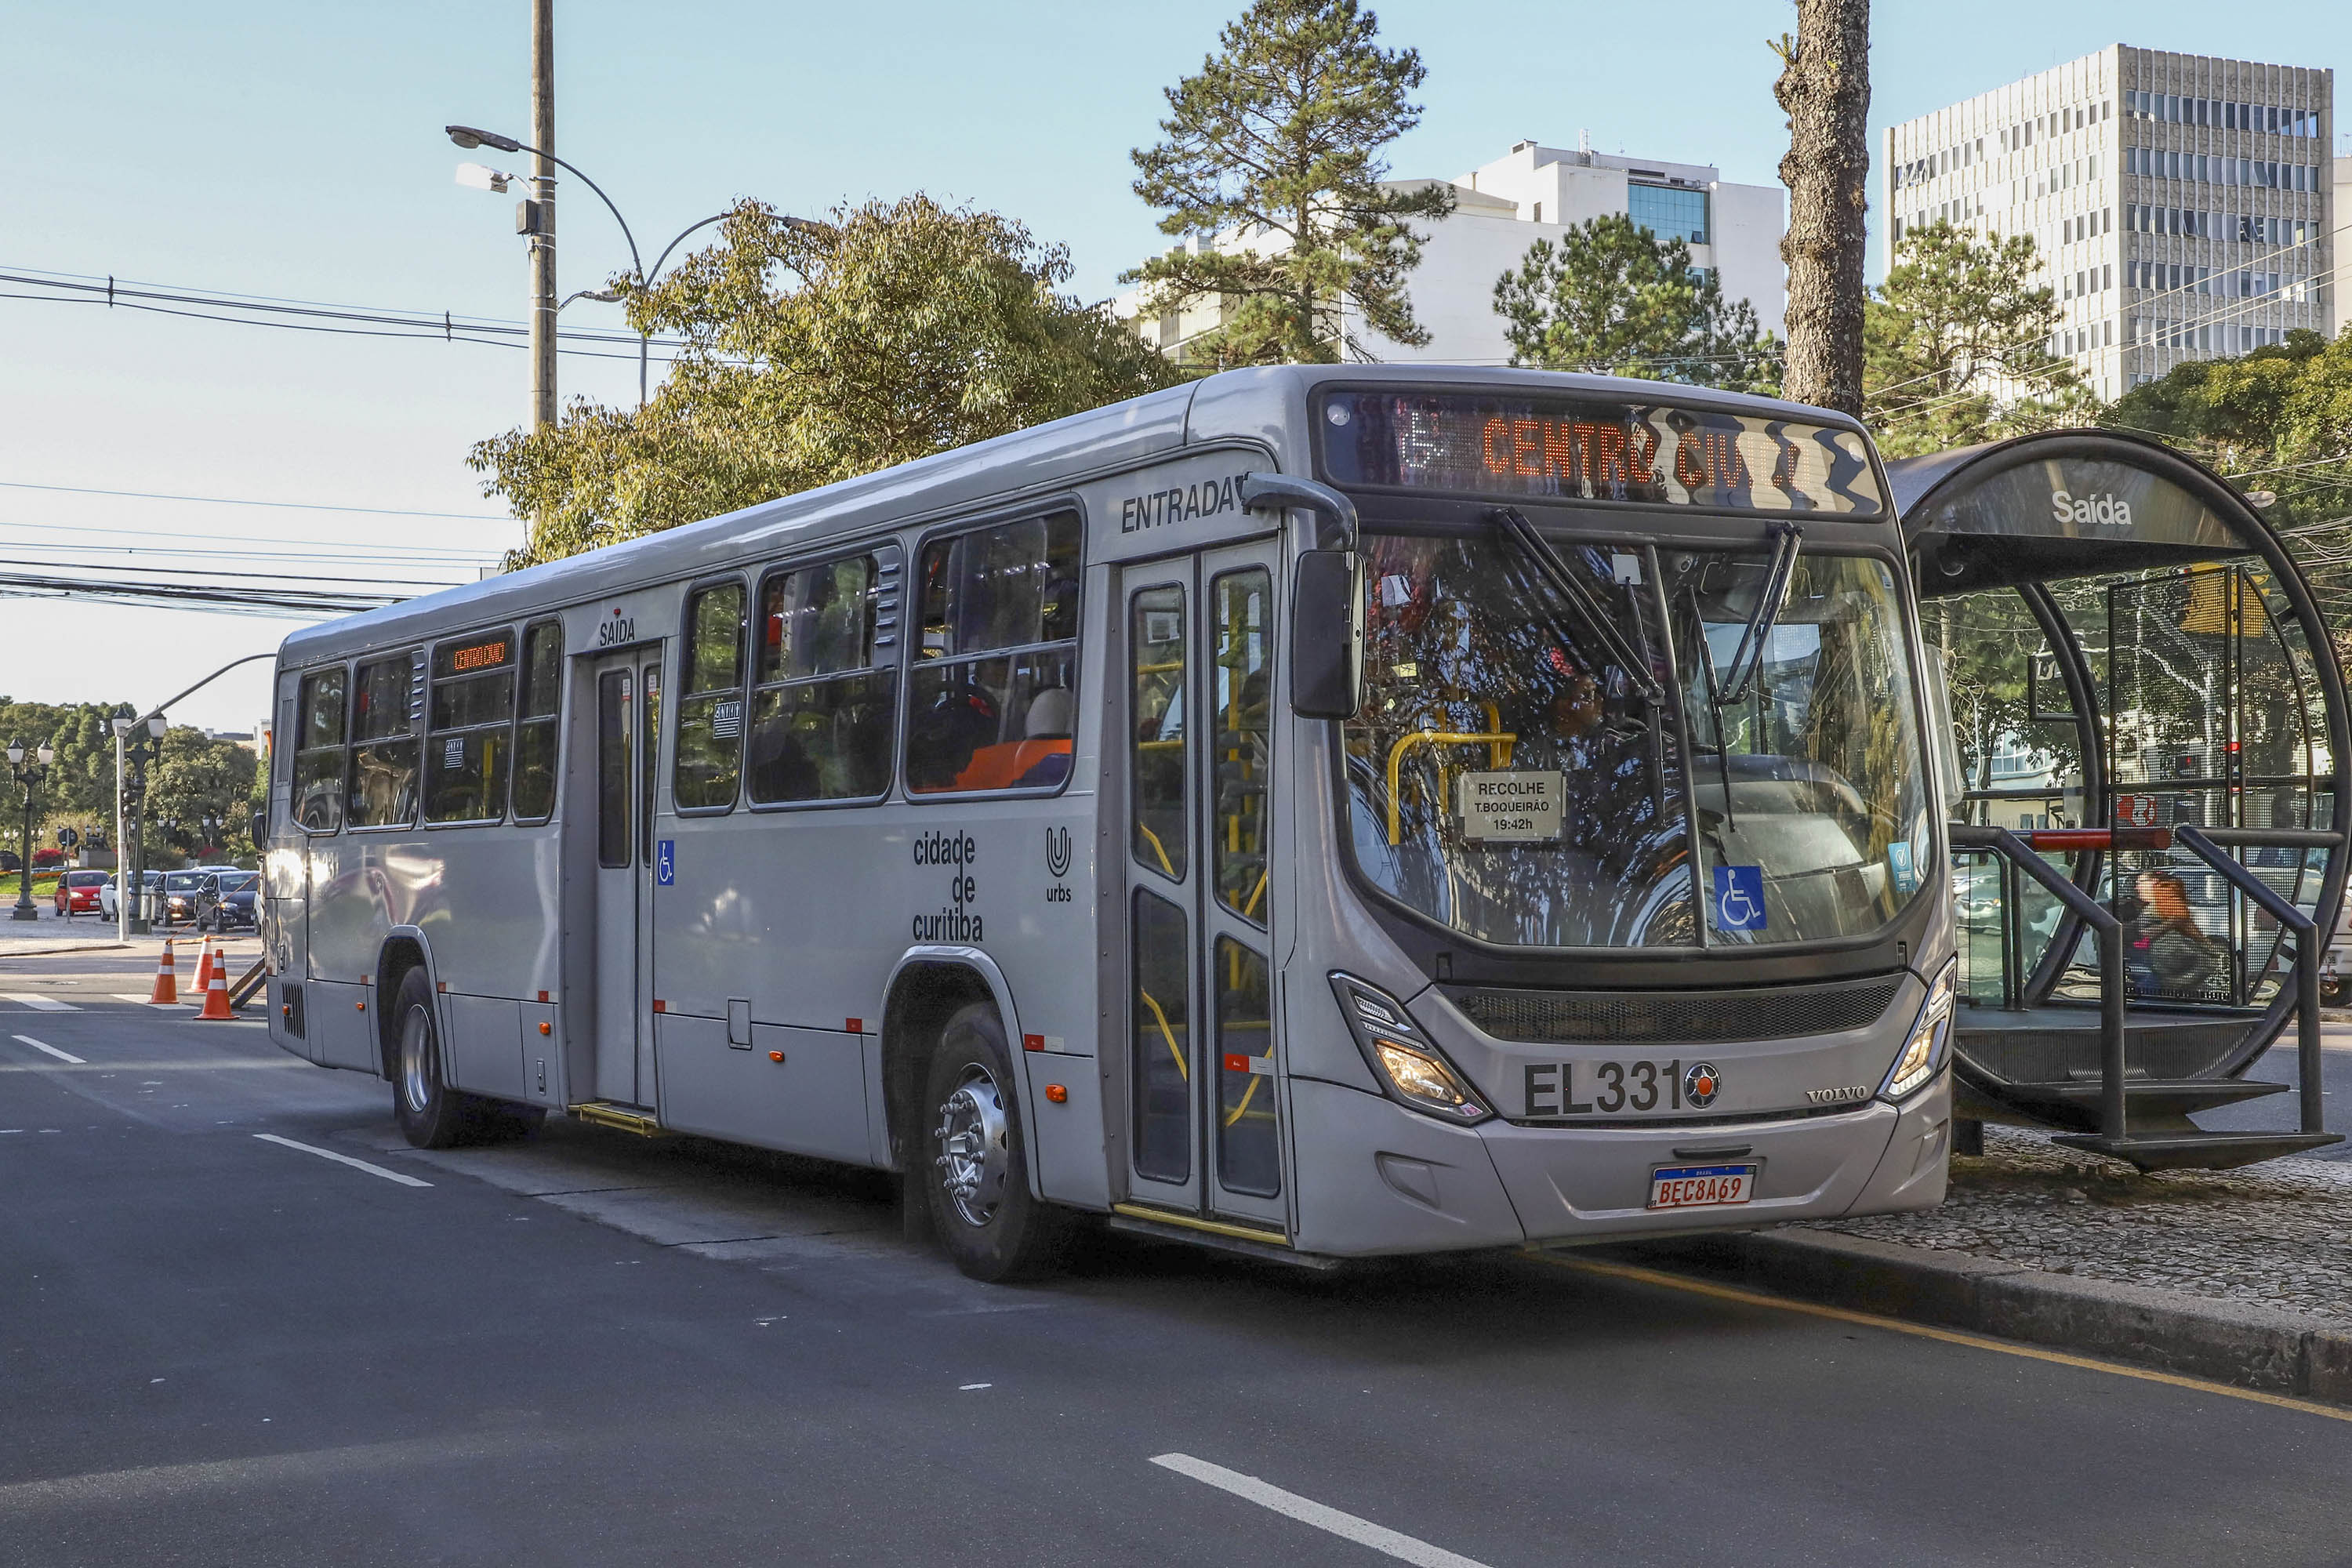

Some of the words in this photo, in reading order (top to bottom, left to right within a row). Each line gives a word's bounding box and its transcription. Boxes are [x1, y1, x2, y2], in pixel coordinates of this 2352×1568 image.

[1483, 418, 1654, 484] CENTRO
[1677, 432, 1810, 493] CIVICO
[1121, 476, 1235, 534] ENTRADA
[2052, 490, 2132, 525] Saída
[1479, 782, 1545, 795] RECOLHE
[1474, 799, 1549, 813] T.BOQUEIRÃO
[1494, 818, 1533, 830] 19:42h
[913, 829, 976, 866] cidade
[1047, 883, 1072, 903] urbs
[913, 906, 983, 942] curitiba
[1524, 1058, 1682, 1117] EL331
[1806, 1085, 1868, 1104] VOLVO
[1659, 1177, 1742, 1204] BEC8A69
